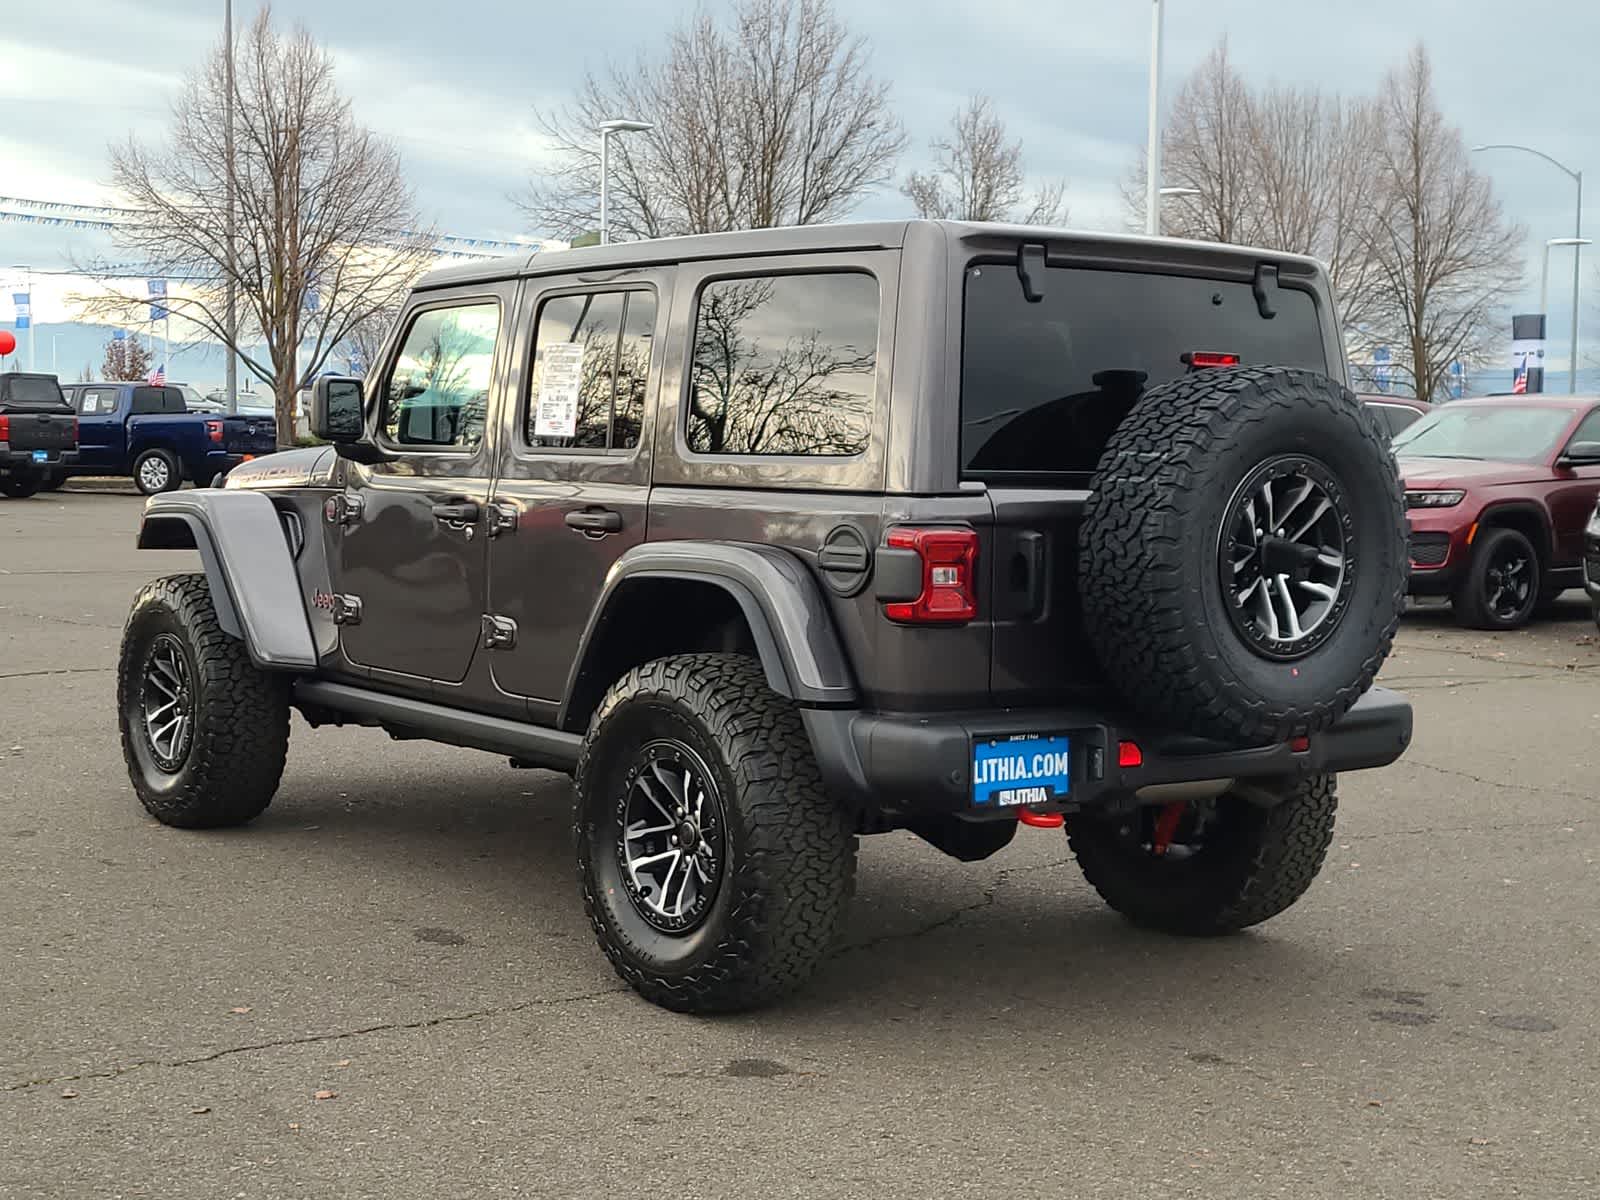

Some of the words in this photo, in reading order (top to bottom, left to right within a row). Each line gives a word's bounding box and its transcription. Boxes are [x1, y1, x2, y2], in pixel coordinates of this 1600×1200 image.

[311, 588, 335, 612] Jeep
[974, 752, 1068, 784] LITHIA.COM
[1010, 787, 1047, 805] LITHIA
